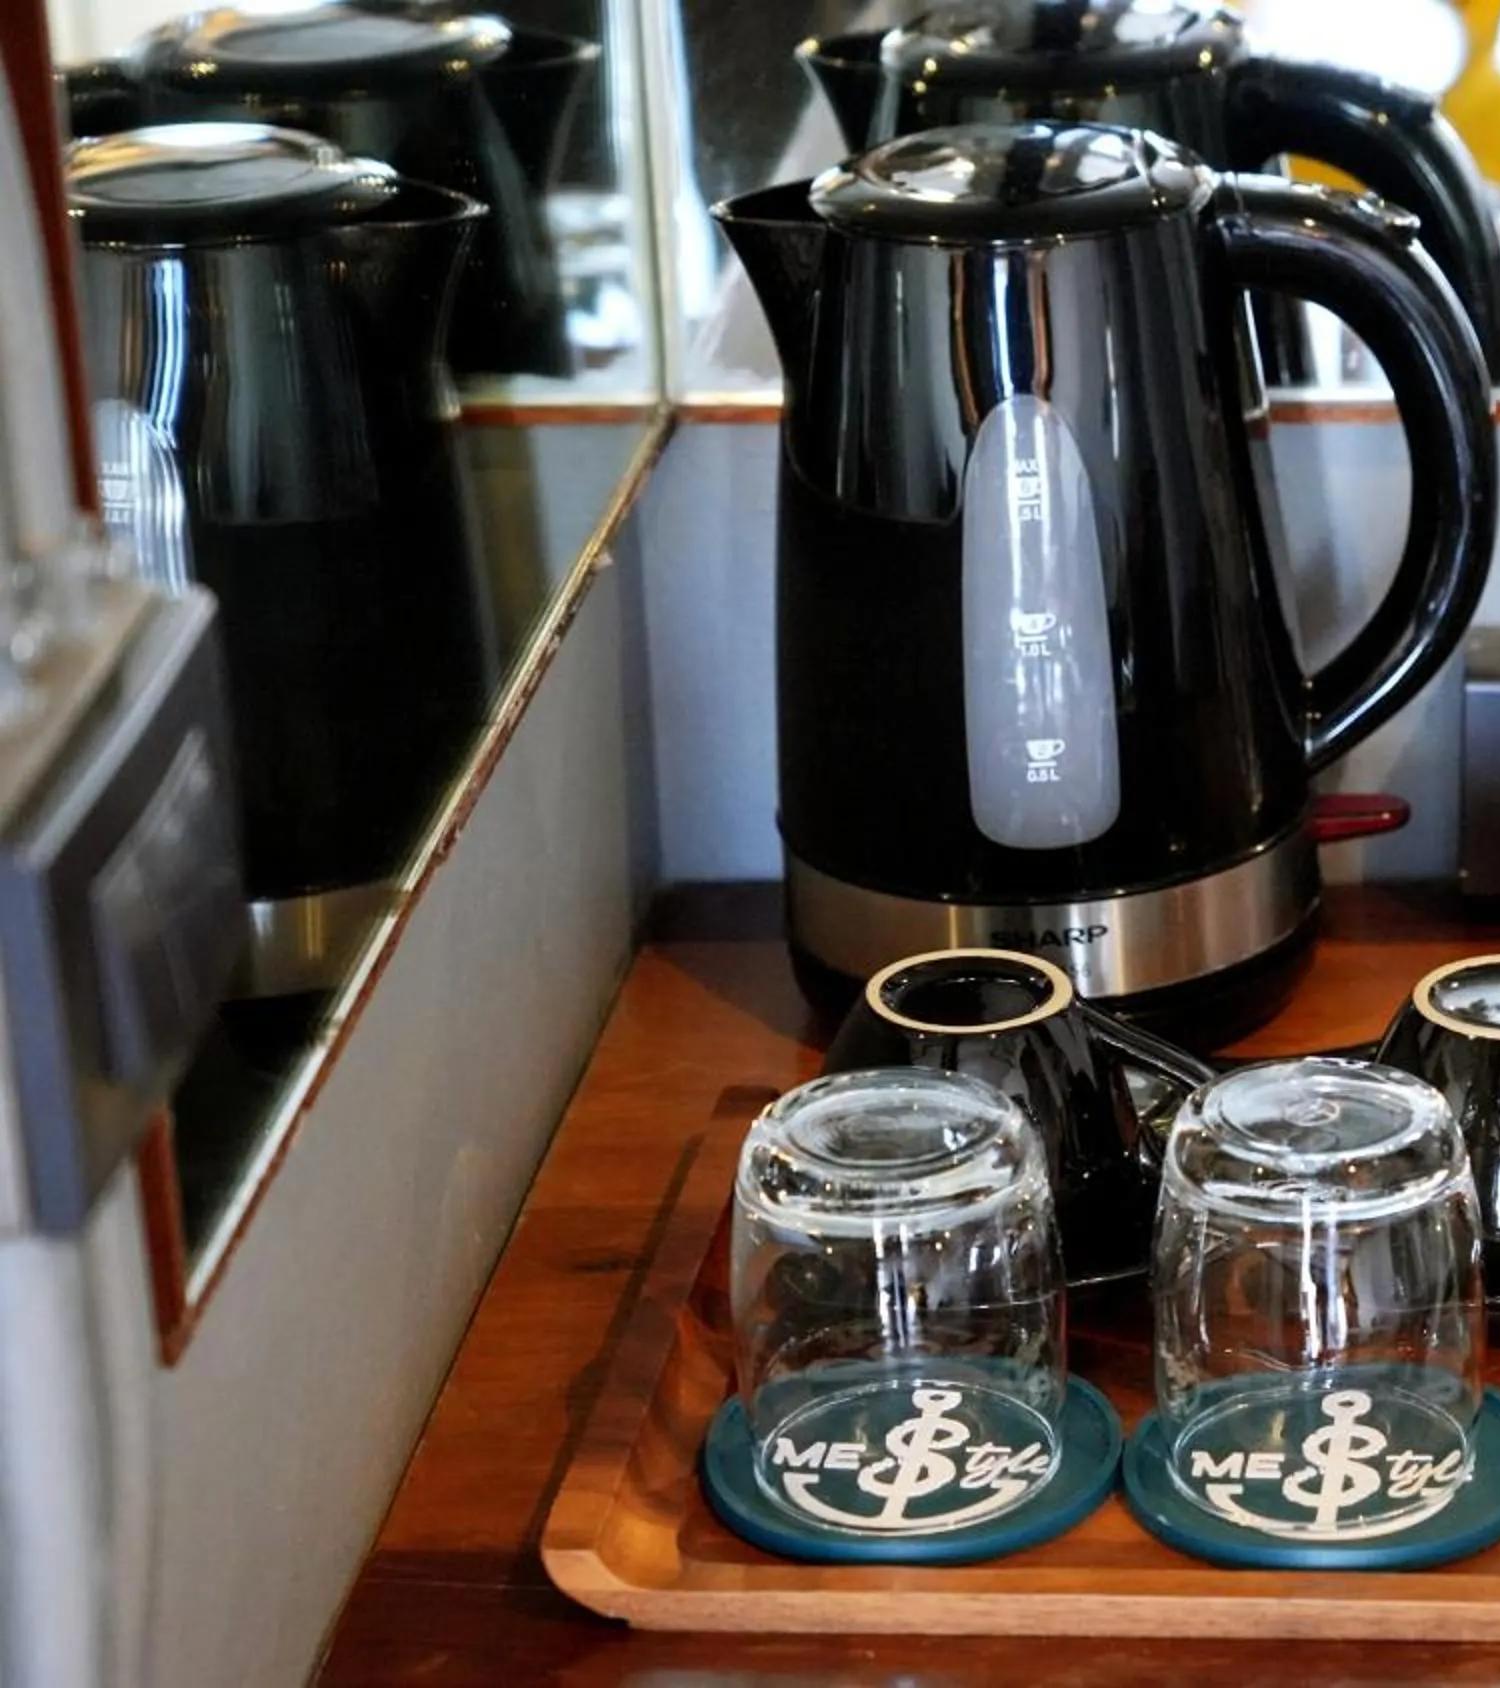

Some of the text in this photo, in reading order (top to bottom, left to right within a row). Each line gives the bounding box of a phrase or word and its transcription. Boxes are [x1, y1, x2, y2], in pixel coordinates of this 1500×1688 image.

[990, 925, 1108, 948] SHARP
[772, 1437, 867, 1470] ME
[1191, 1451, 1285, 1479] ME
